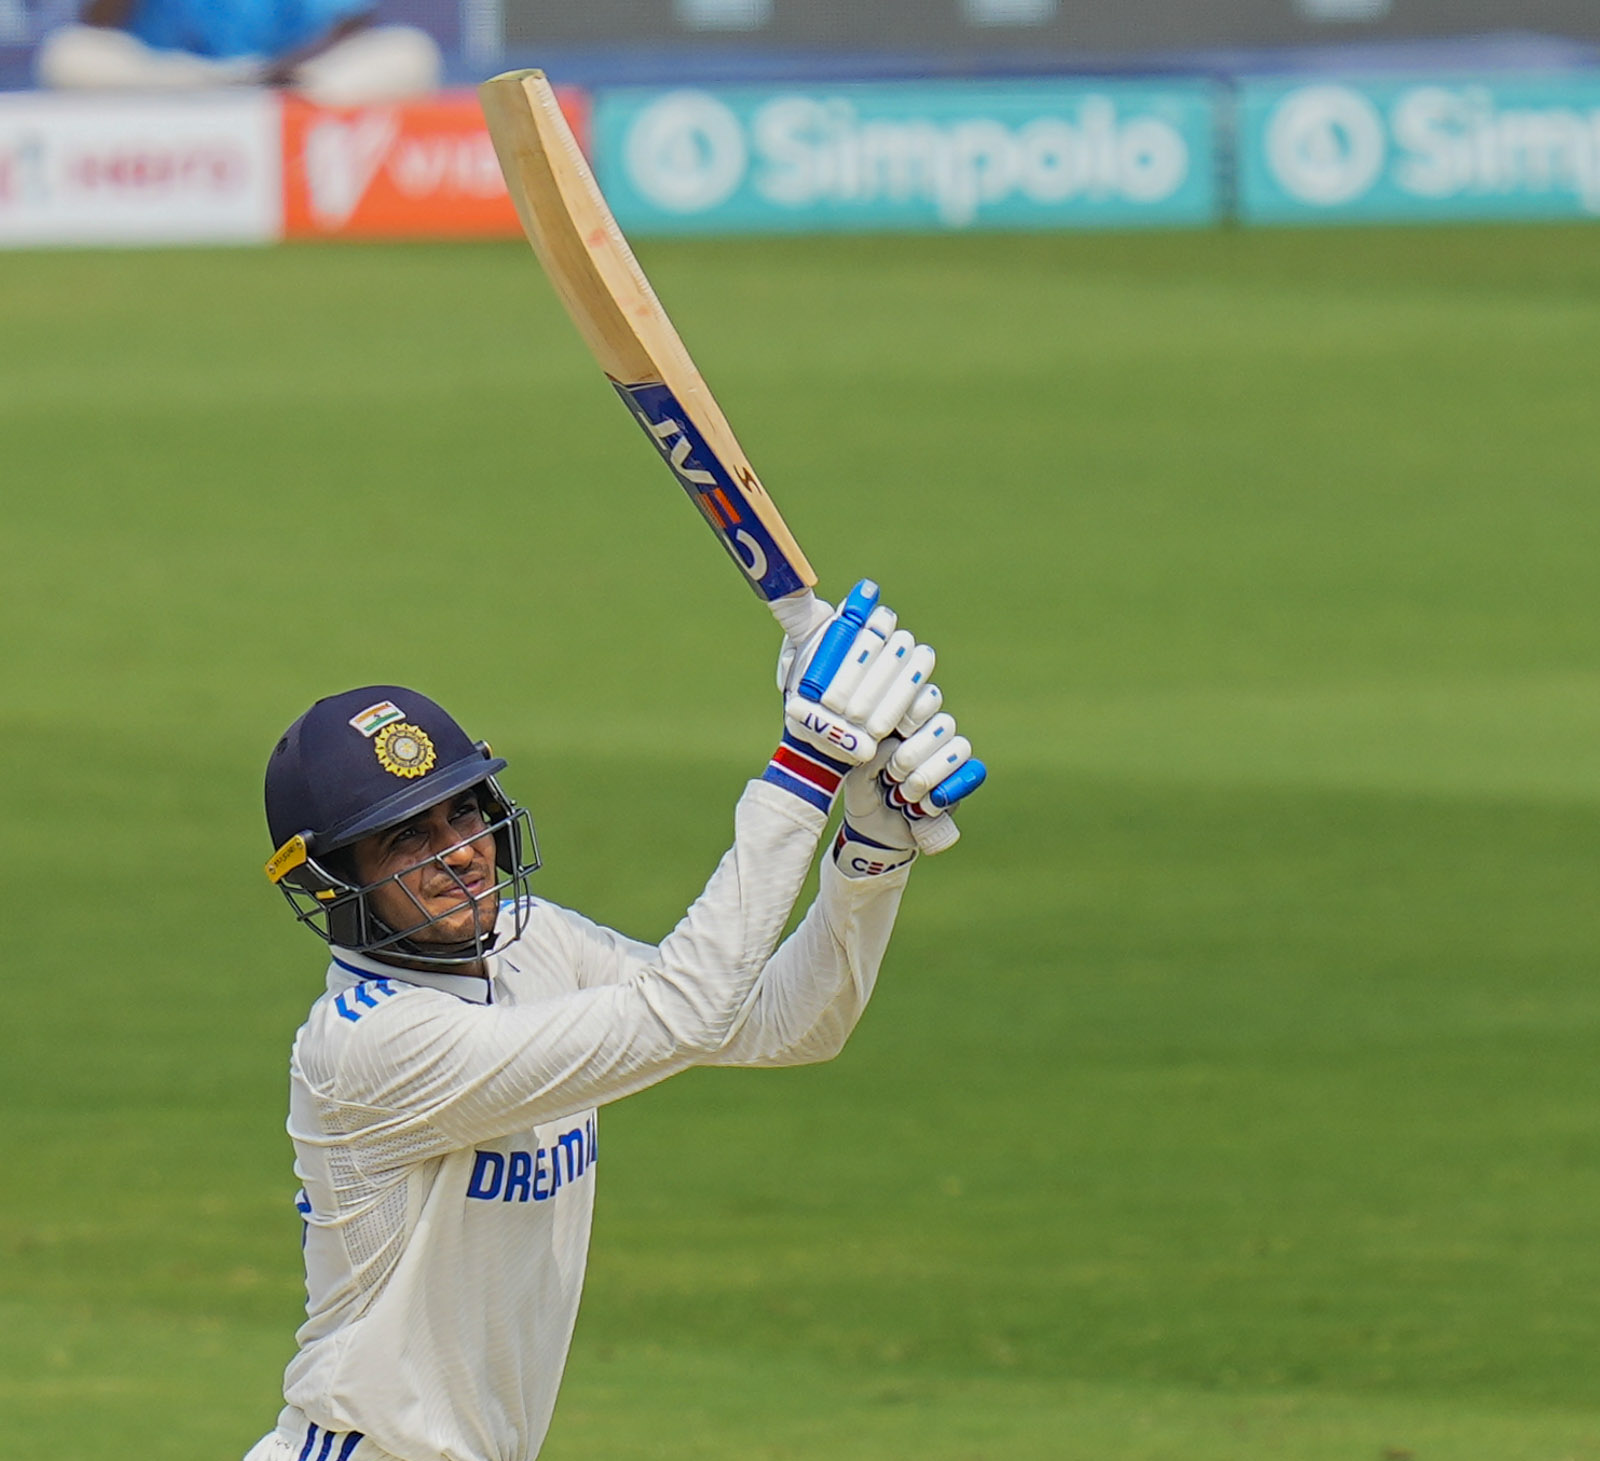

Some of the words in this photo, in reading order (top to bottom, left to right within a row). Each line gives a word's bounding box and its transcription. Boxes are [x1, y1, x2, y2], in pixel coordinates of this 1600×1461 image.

[390, 132, 508, 198] VID
[752, 94, 1190, 228] Simpolo
[804, 712, 858, 751] CEAT
[851, 857, 908, 876] CE
